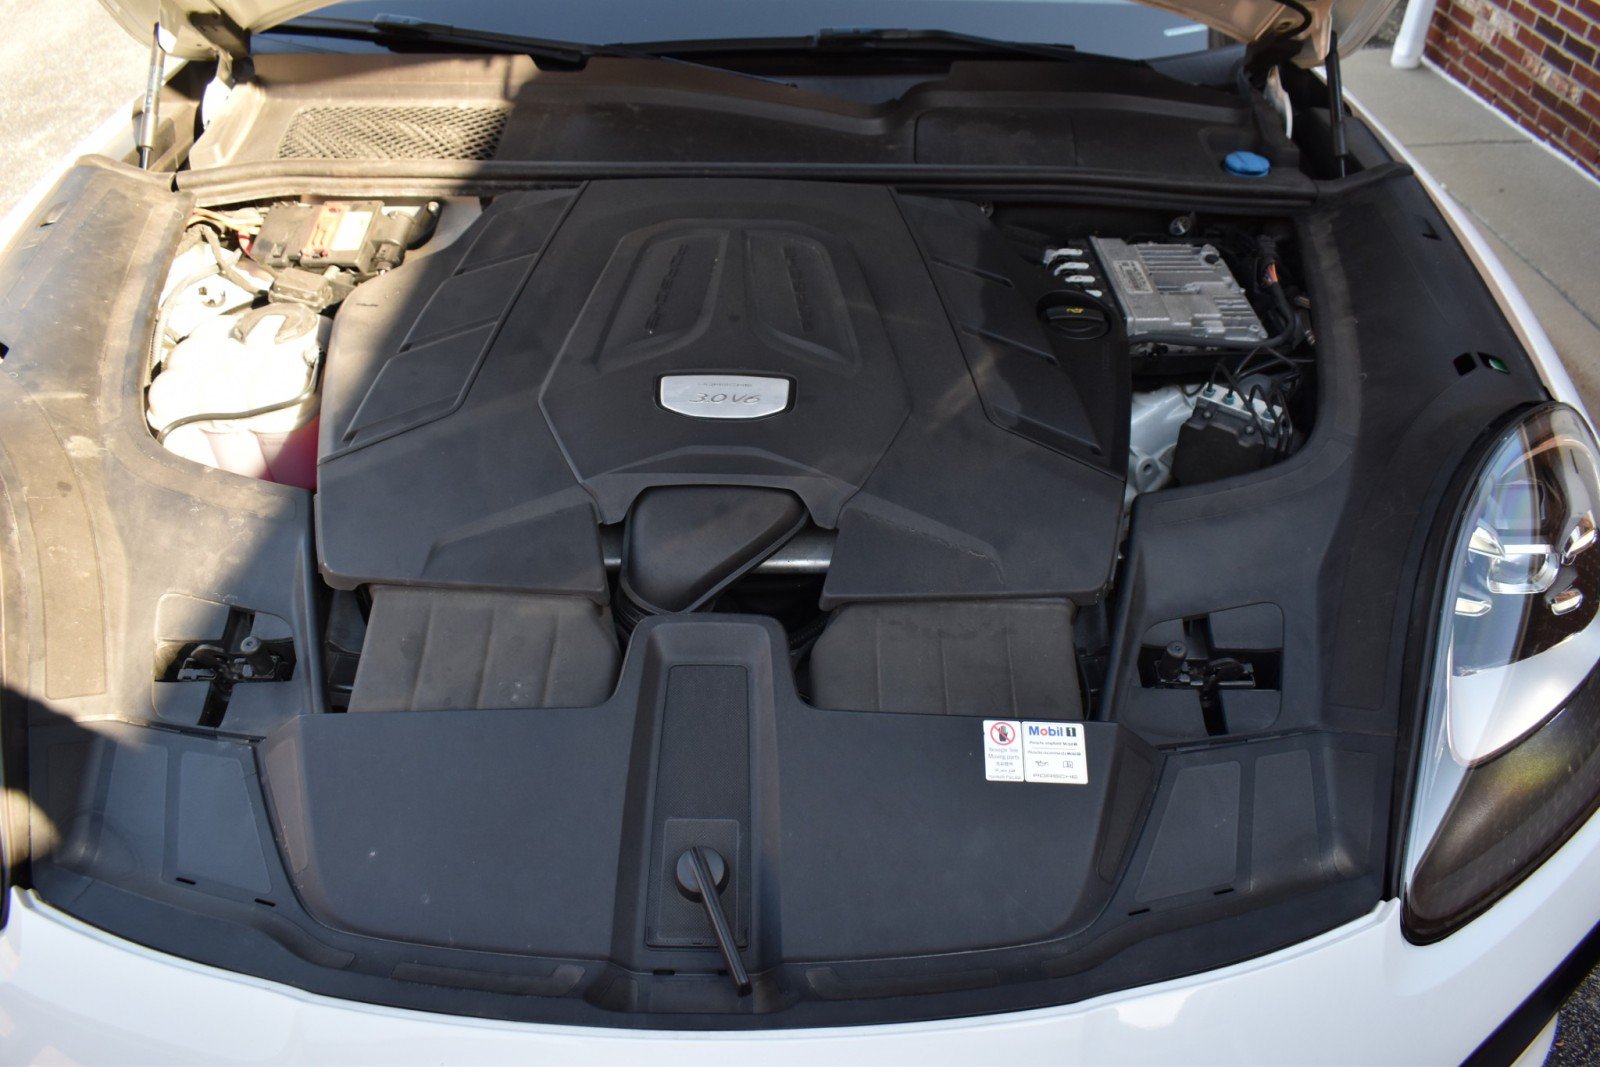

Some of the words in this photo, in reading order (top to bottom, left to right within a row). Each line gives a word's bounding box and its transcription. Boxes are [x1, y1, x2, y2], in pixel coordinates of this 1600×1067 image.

[731, 393, 761, 403] V6
[1028, 725, 1064, 737] Mobil
[1066, 726, 1077, 737] 1
